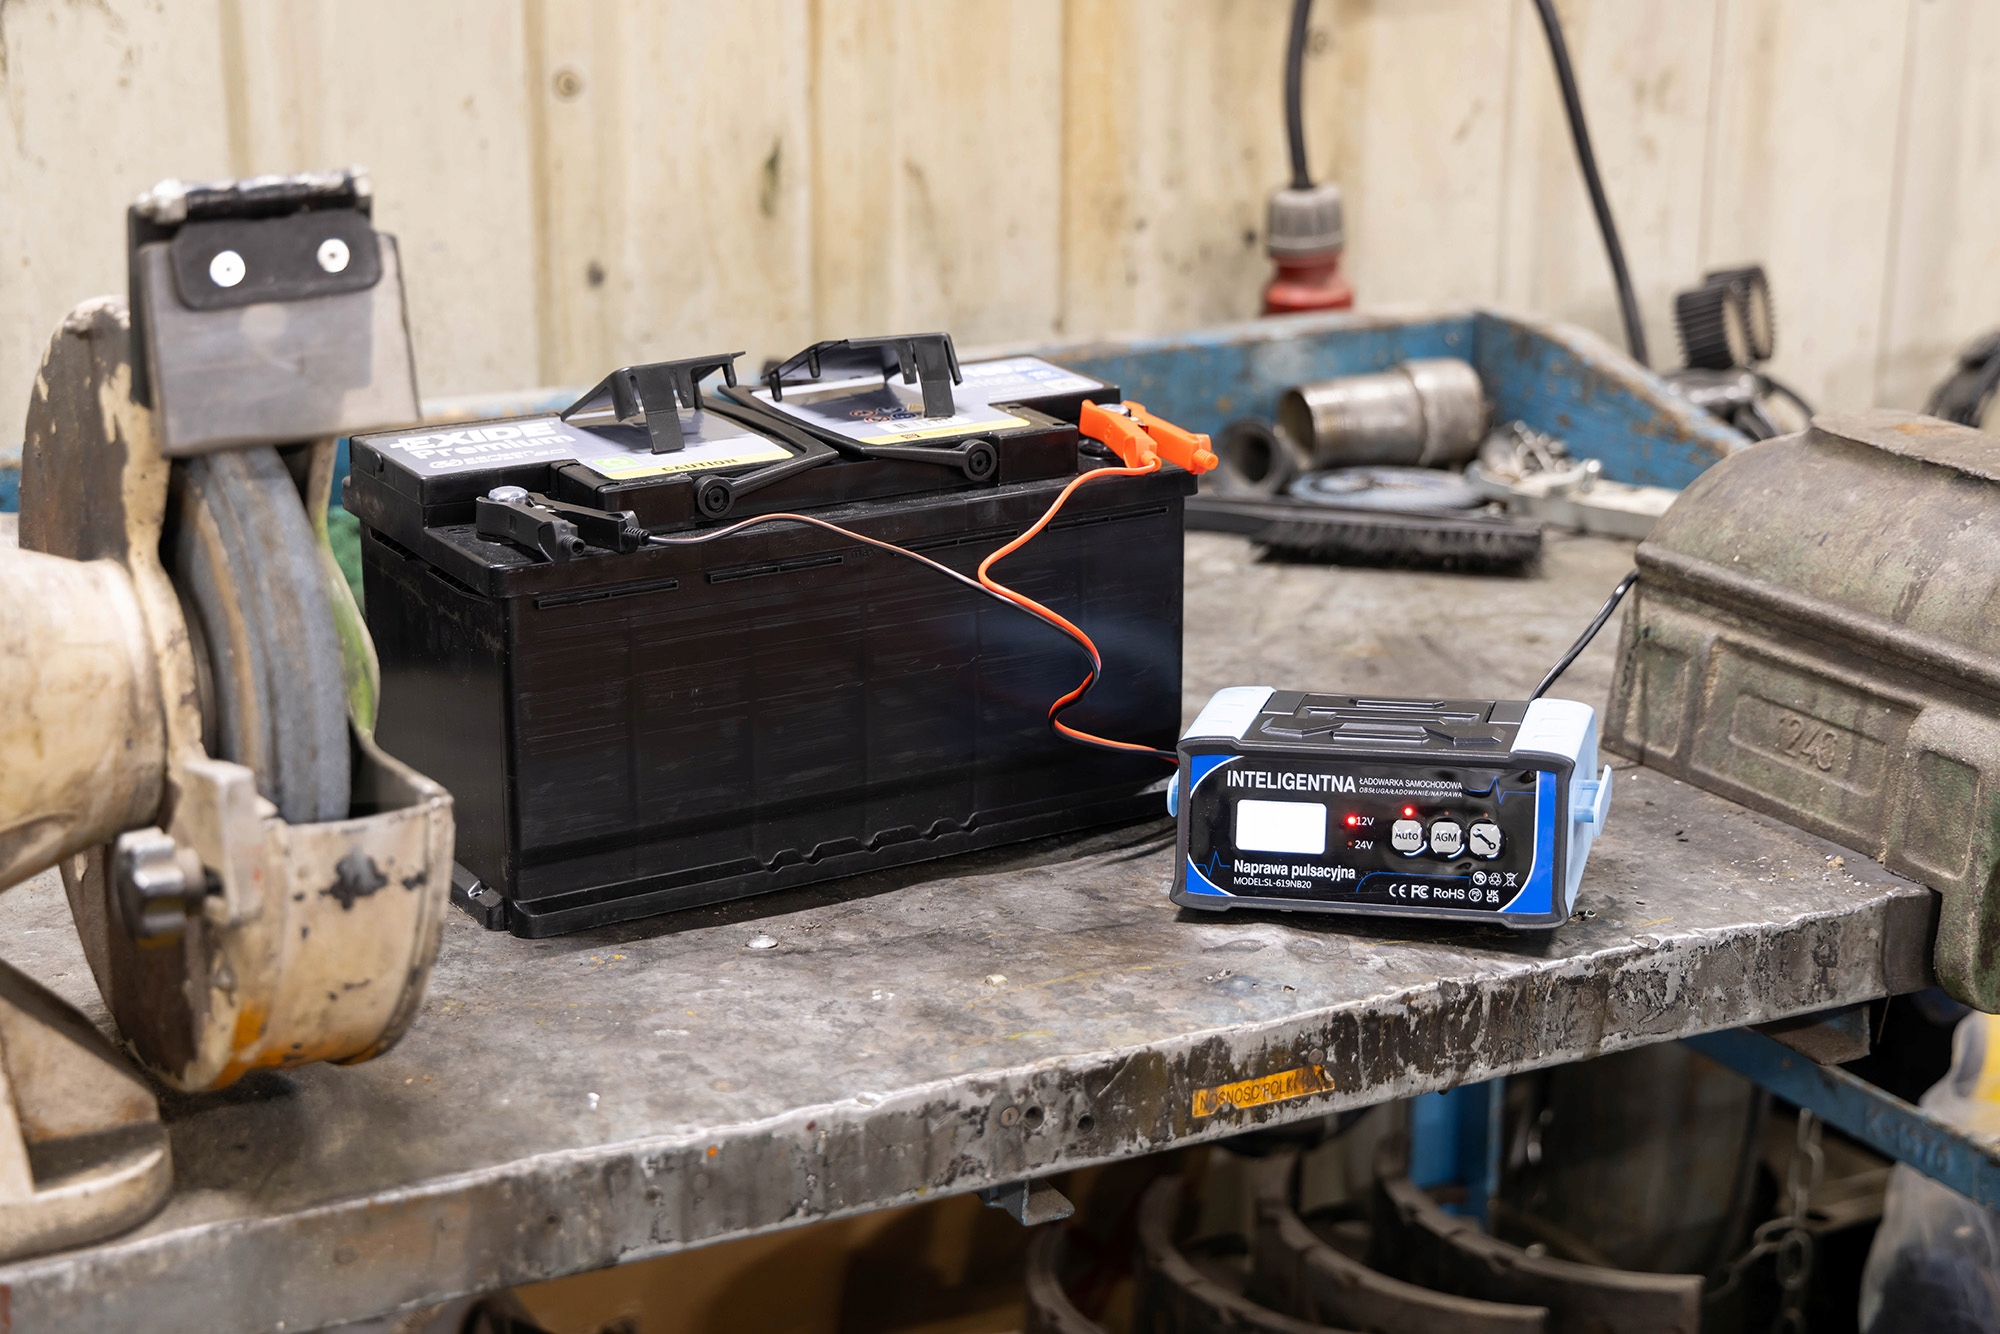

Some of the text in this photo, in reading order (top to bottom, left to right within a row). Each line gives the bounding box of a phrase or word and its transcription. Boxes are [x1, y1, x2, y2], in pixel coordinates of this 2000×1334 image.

[390, 422, 556, 451] EXIDE
[408, 435, 576, 459] Premium
[662, 459, 737, 472] CAUTION
[1227, 770, 1356, 793] INTELIGENTNA
[1359, 777, 1462, 789] ŁADOWARKA SAMOCHODOWA
[1355, 817, 1374, 826] 12V
[1394, 831, 1457, 842] Auto AGM
[1354, 840, 1373, 849] 24V
[1234, 859, 1356, 881] Naprawa pulsacyjna
[1433, 888, 1465, 899] RoHS
